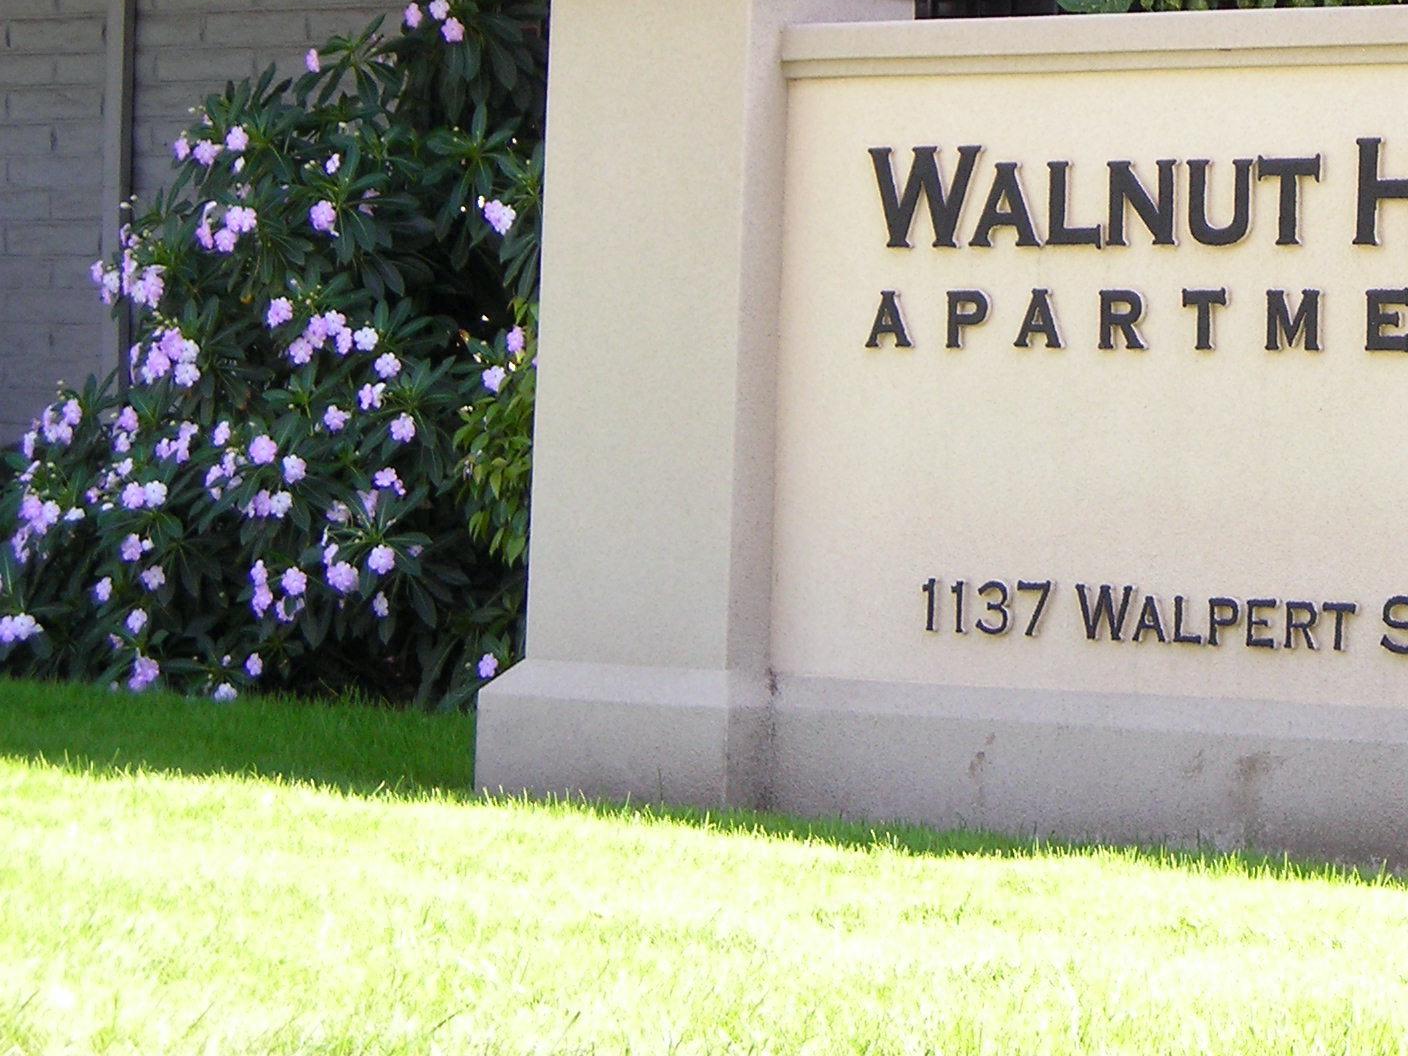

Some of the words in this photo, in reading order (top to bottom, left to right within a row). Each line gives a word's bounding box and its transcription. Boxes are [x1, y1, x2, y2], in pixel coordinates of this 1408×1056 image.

[867, 145, 1322, 250] WALNUT
[922, 578, 1053, 638] 1137
[1074, 583, 1358, 652] WALPERT
